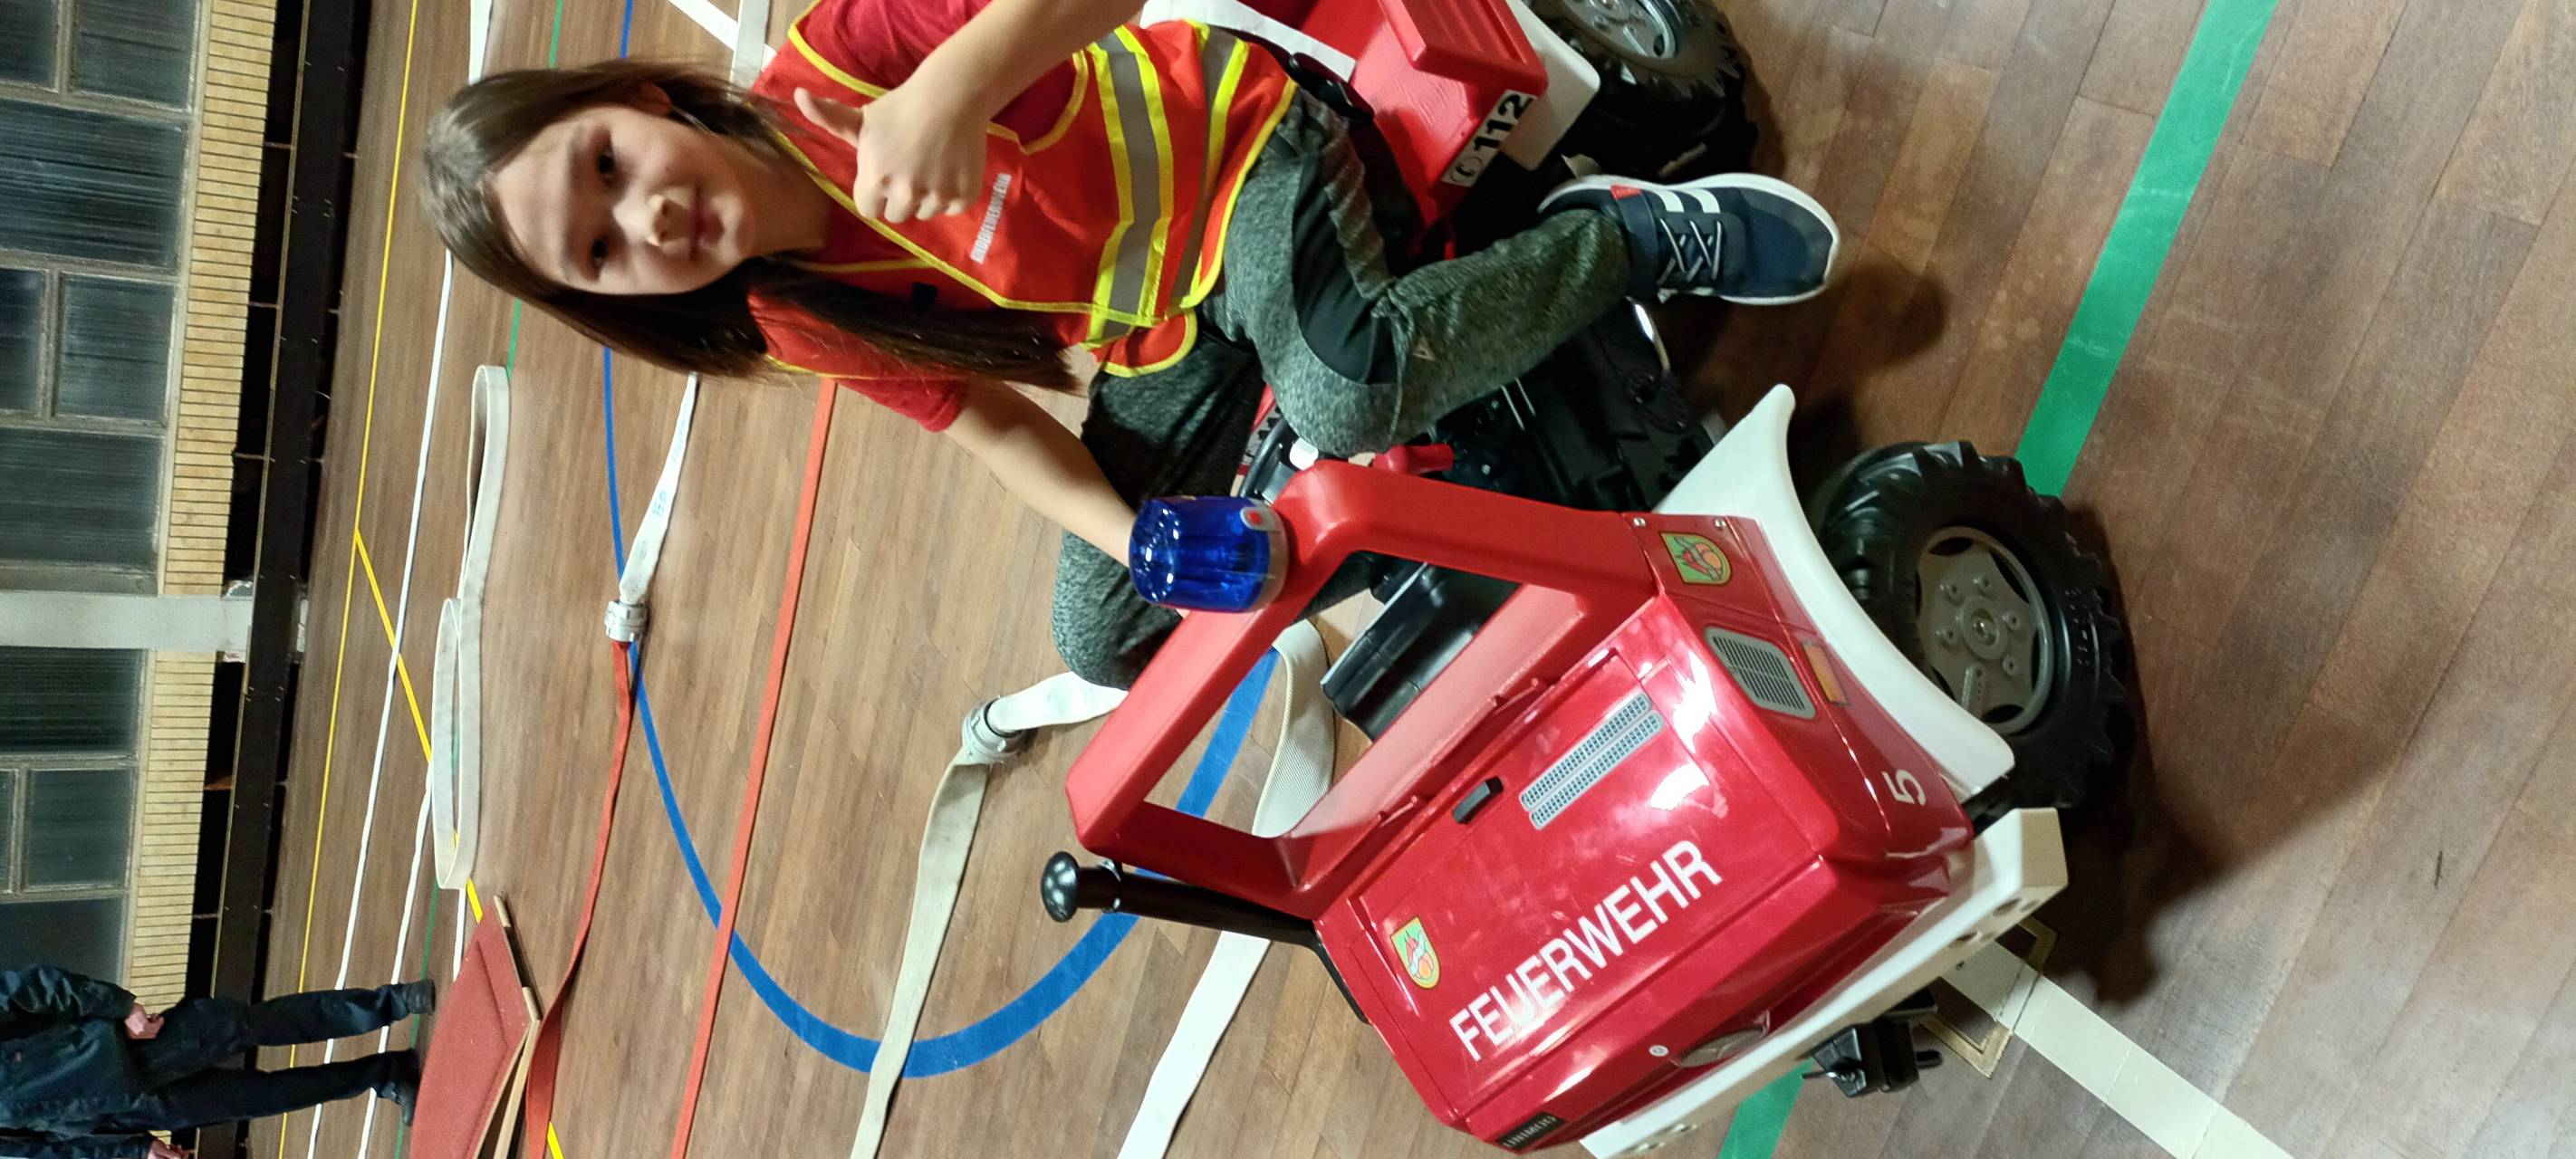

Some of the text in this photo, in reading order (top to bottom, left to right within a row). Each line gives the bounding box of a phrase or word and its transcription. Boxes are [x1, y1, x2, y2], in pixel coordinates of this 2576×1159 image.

[1473, 93, 1533, 150] 112
[1881, 769, 1927, 806] 5
[1448, 839, 1723, 1062] FEUERWEHR
